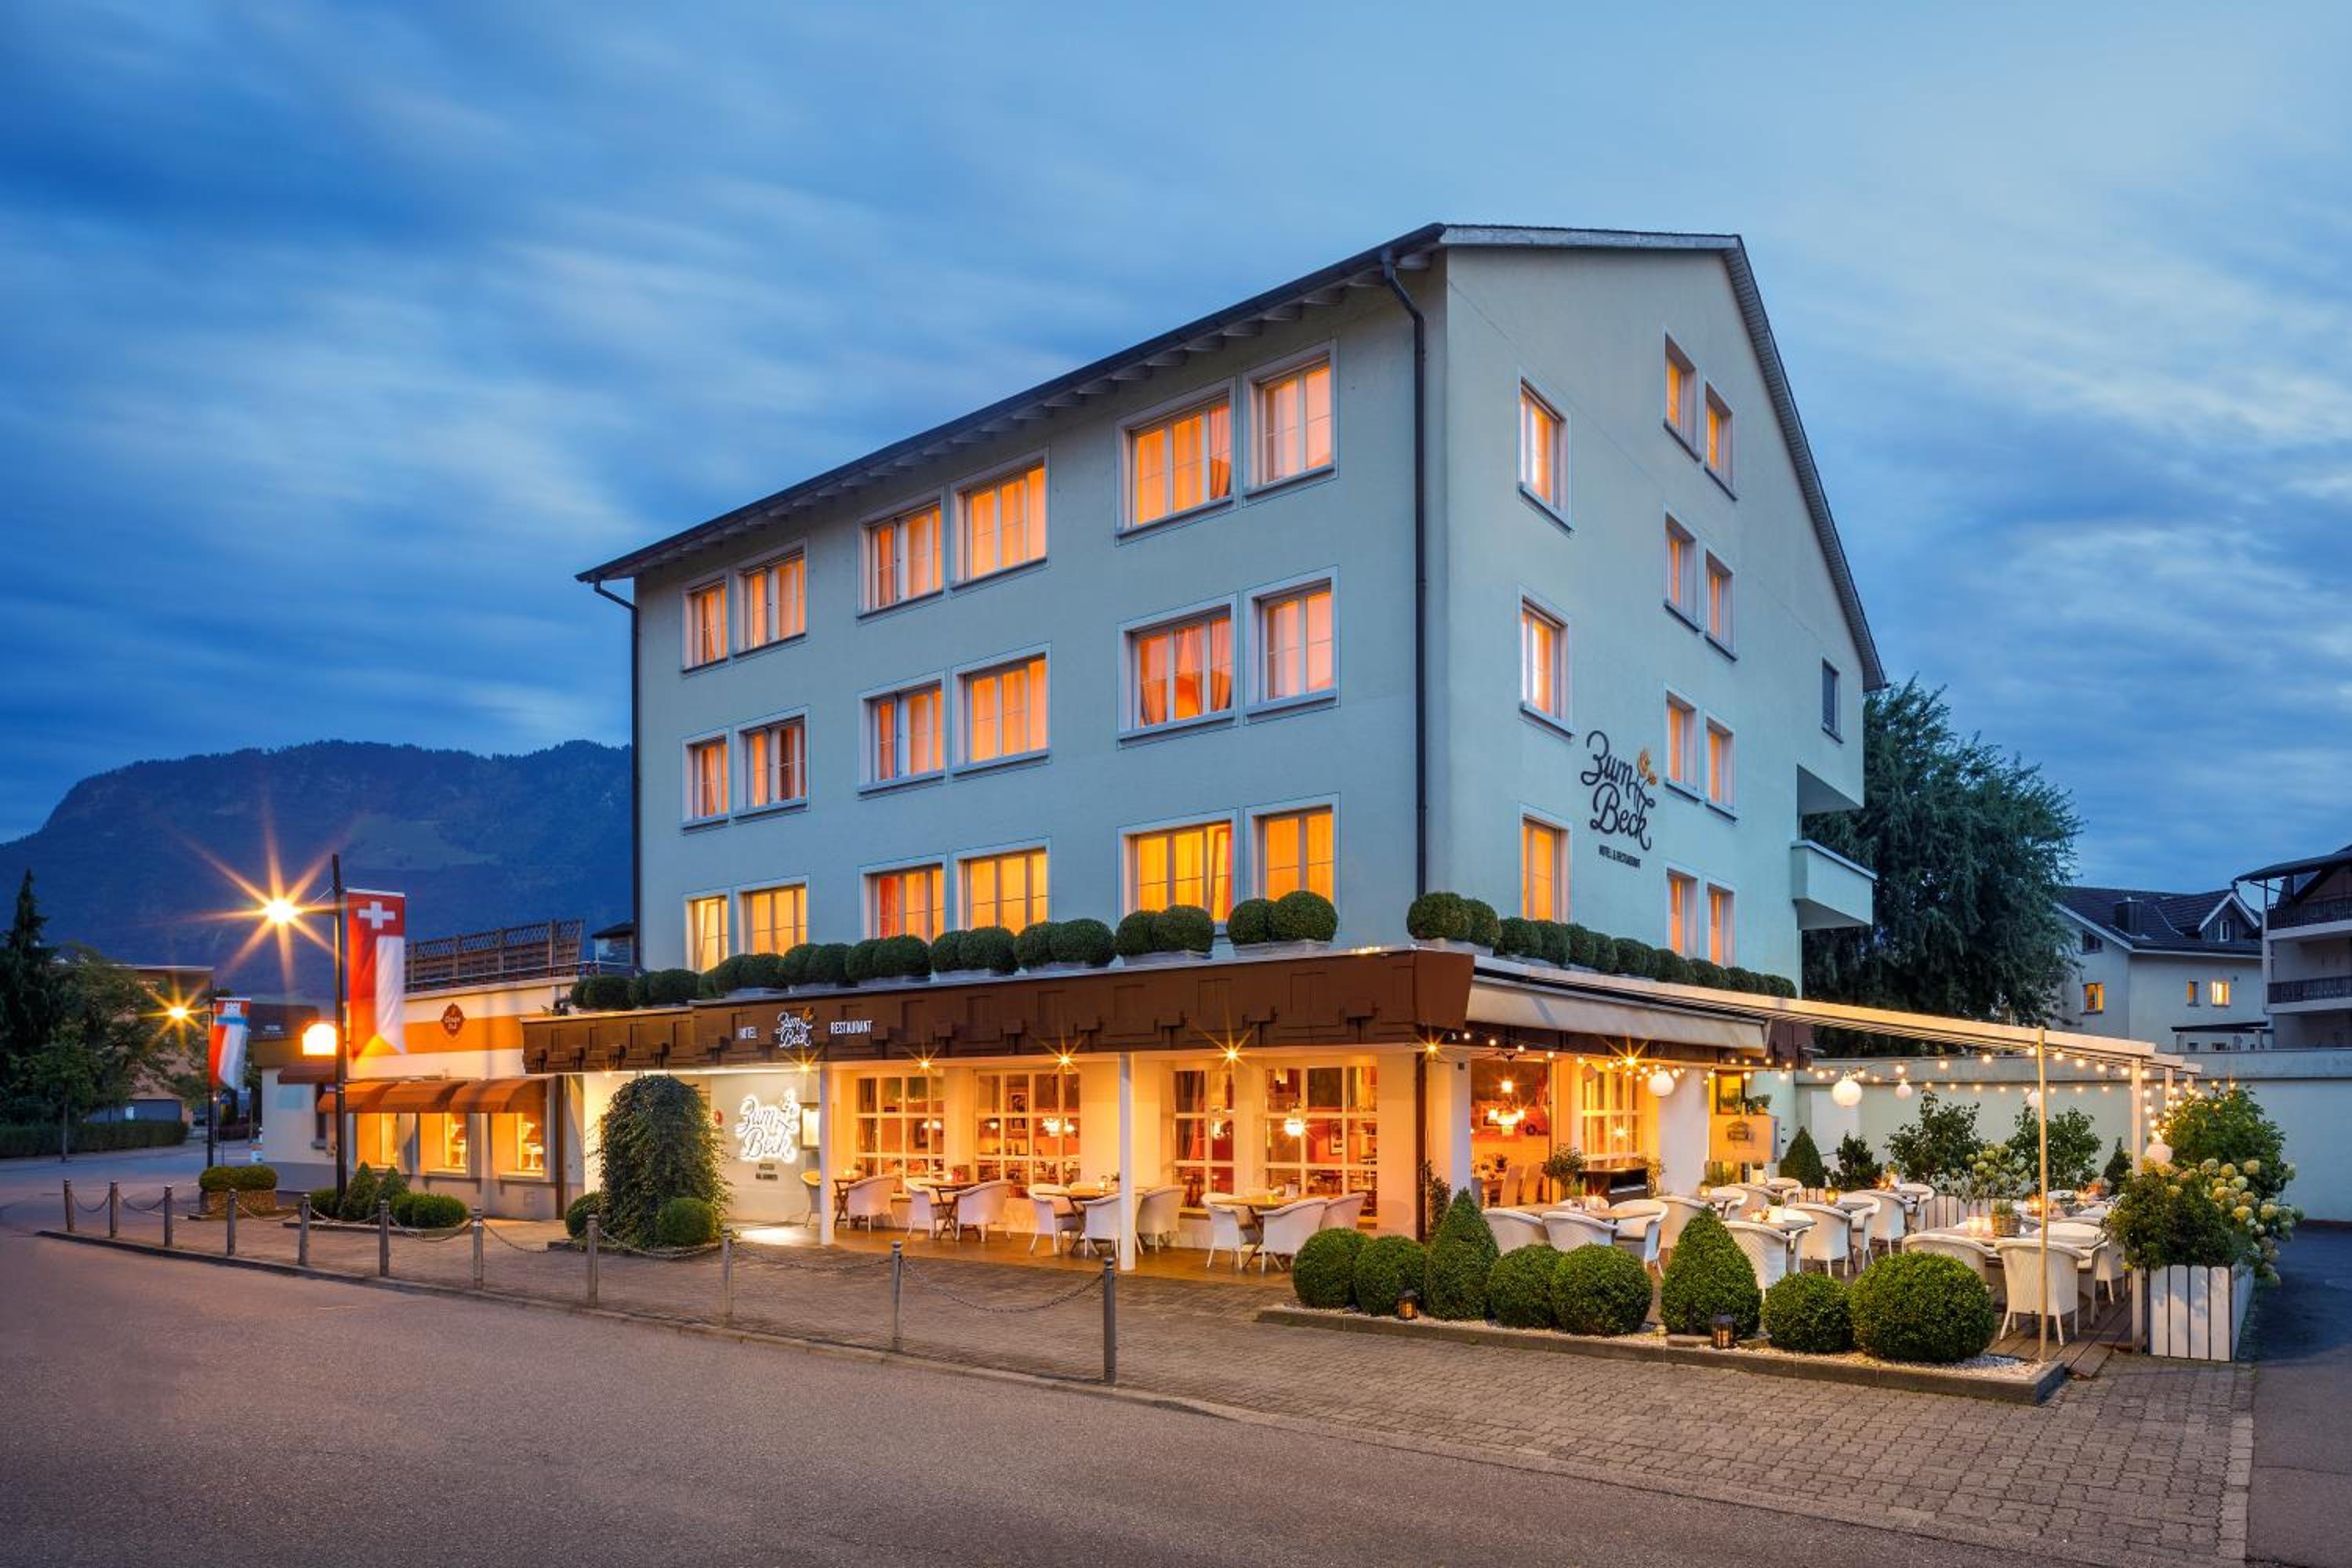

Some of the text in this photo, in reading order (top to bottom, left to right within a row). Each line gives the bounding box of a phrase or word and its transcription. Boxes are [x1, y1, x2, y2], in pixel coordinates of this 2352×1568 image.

[1581, 730, 1634, 800] Zum
[1590, 782, 1652, 851] Beck
[775, 1011, 801, 1033] Zum
[779, 1028, 811, 1048] Beck
[830, 1020, 873, 1035] RESTAURANT
[737, 1097, 779, 1135] Zum
[739, 1127, 796, 1162] Beck
